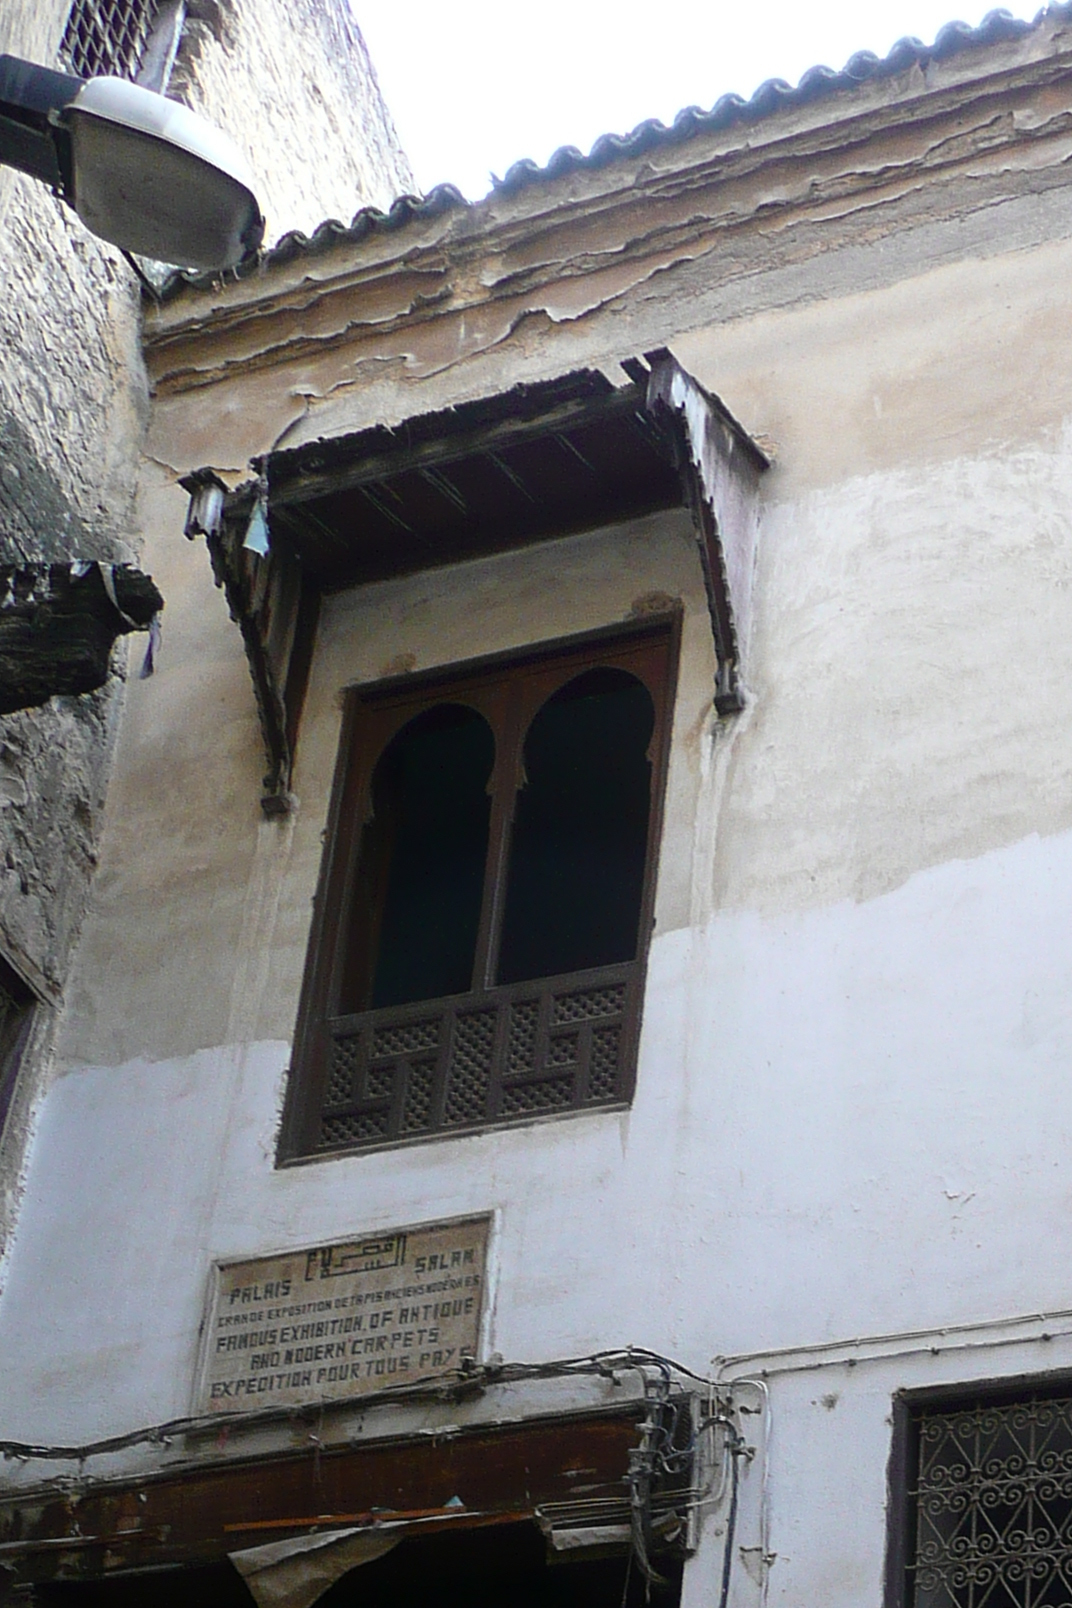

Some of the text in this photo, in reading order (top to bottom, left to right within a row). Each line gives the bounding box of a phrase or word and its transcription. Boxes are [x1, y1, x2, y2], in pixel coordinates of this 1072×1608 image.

[230, 1248, 475, 1306] PALAIS SALAM
[267, 1301, 332, 1320] EXPOSITION
[334, 1297, 349, 1309] DE
[350, 1290, 383, 1307] TAPIS
[384, 1284, 425, 1300] ANCIENS
[216, 1327, 279, 1353] FAMOUS
[369, 1310, 393, 1330] OF
[398, 1297, 475, 1325] ANTIQUE
[251, 1327, 440, 1370] AND MODERN CARPETS
[210, 1345, 473, 1399] EXPEDITION POUR TOUS PAYS
